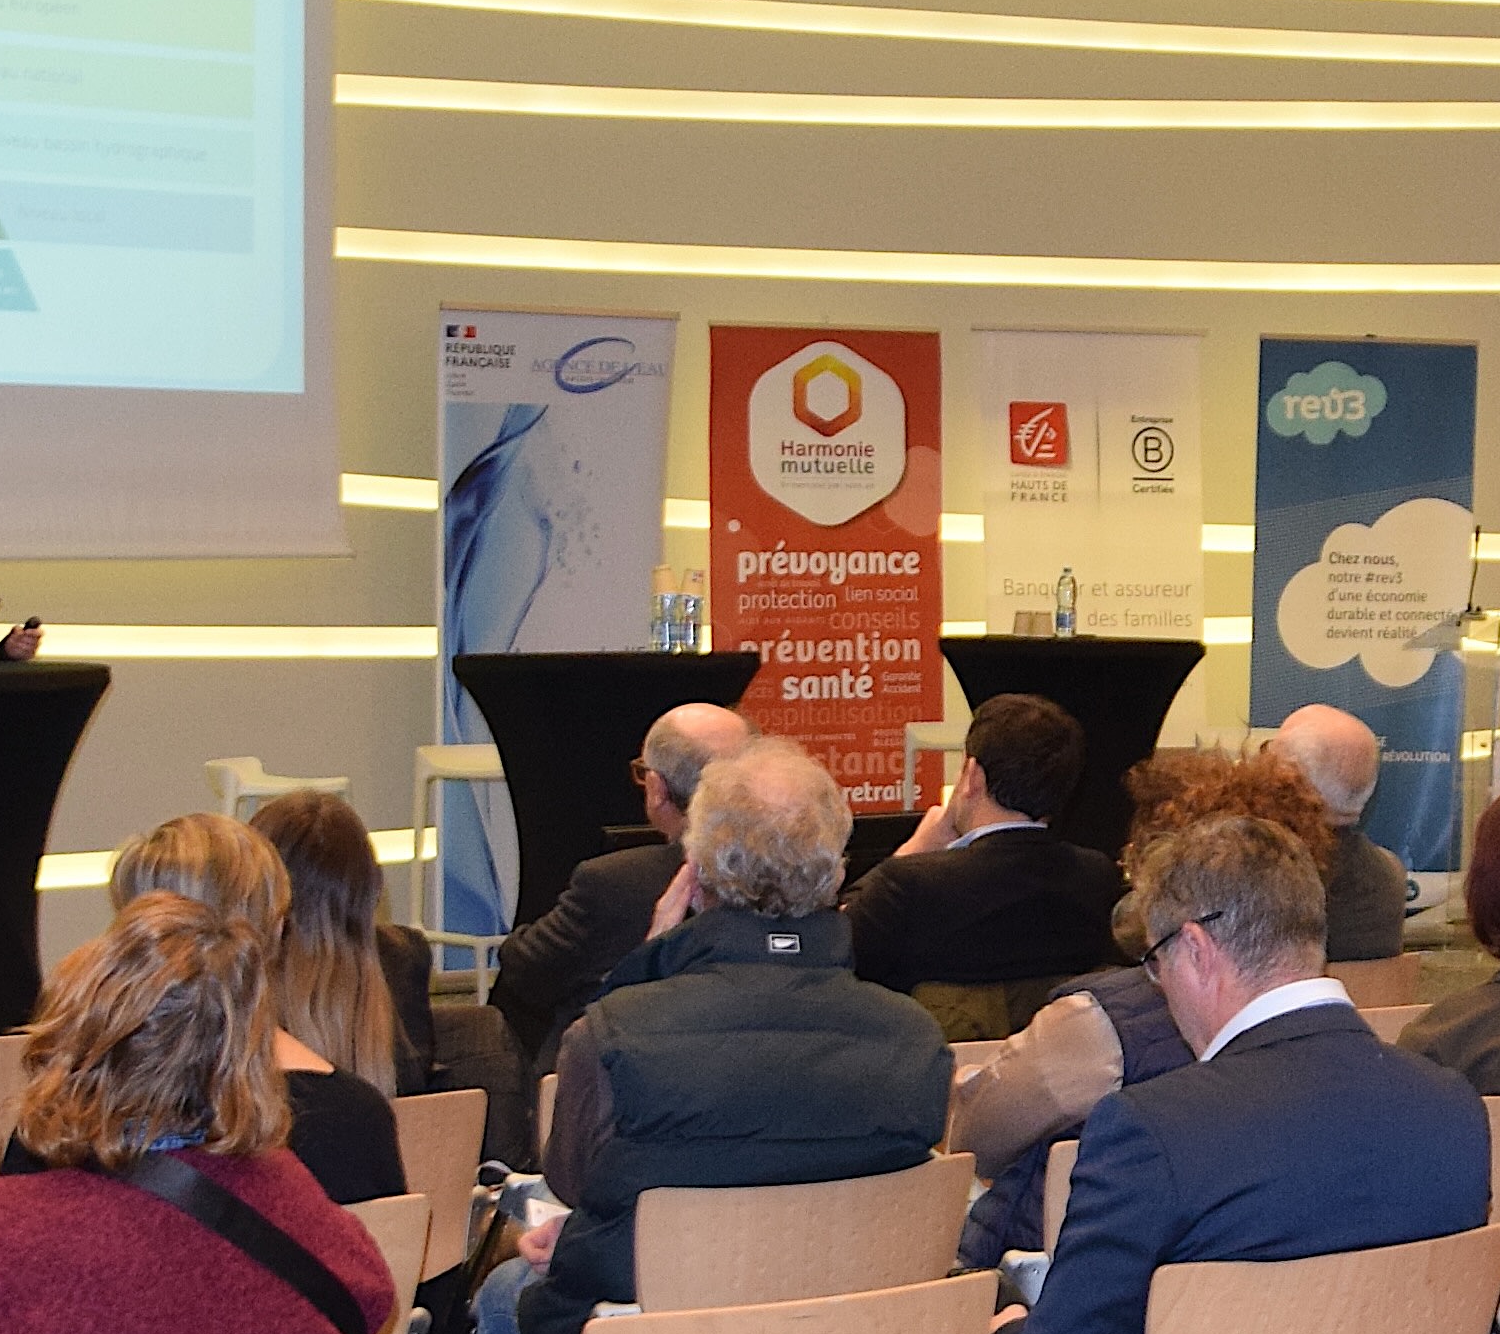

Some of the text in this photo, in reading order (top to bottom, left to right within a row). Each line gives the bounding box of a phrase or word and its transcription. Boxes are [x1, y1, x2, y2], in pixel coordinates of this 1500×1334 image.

[781, 440, 875, 458] Harmonie
[781, 457, 875, 475] mutuelle
[1010, 491, 1069, 503] FRANCE
[737, 539, 922, 585] prévoyance
[1328, 551, 1400, 568] Chez nous,
[1327, 571, 1404, 584] notre #rev3
[844, 585, 920, 603] lien social
[1091, 580, 1109, 597] et
[1114, 582, 1193, 598] assureur
[1327, 588, 1428, 603] d'une économie
[737, 589, 838, 615] protection
[828, 606, 921, 631] conseils
[1087, 607, 1193, 628] des familles
[1327, 606, 1377, 621] durable
[1379, 609, 1392, 621] et
[1326, 626, 1374, 640] devient
[782, 664, 874, 700] santé
[842, 778, 923, 803] retraie
